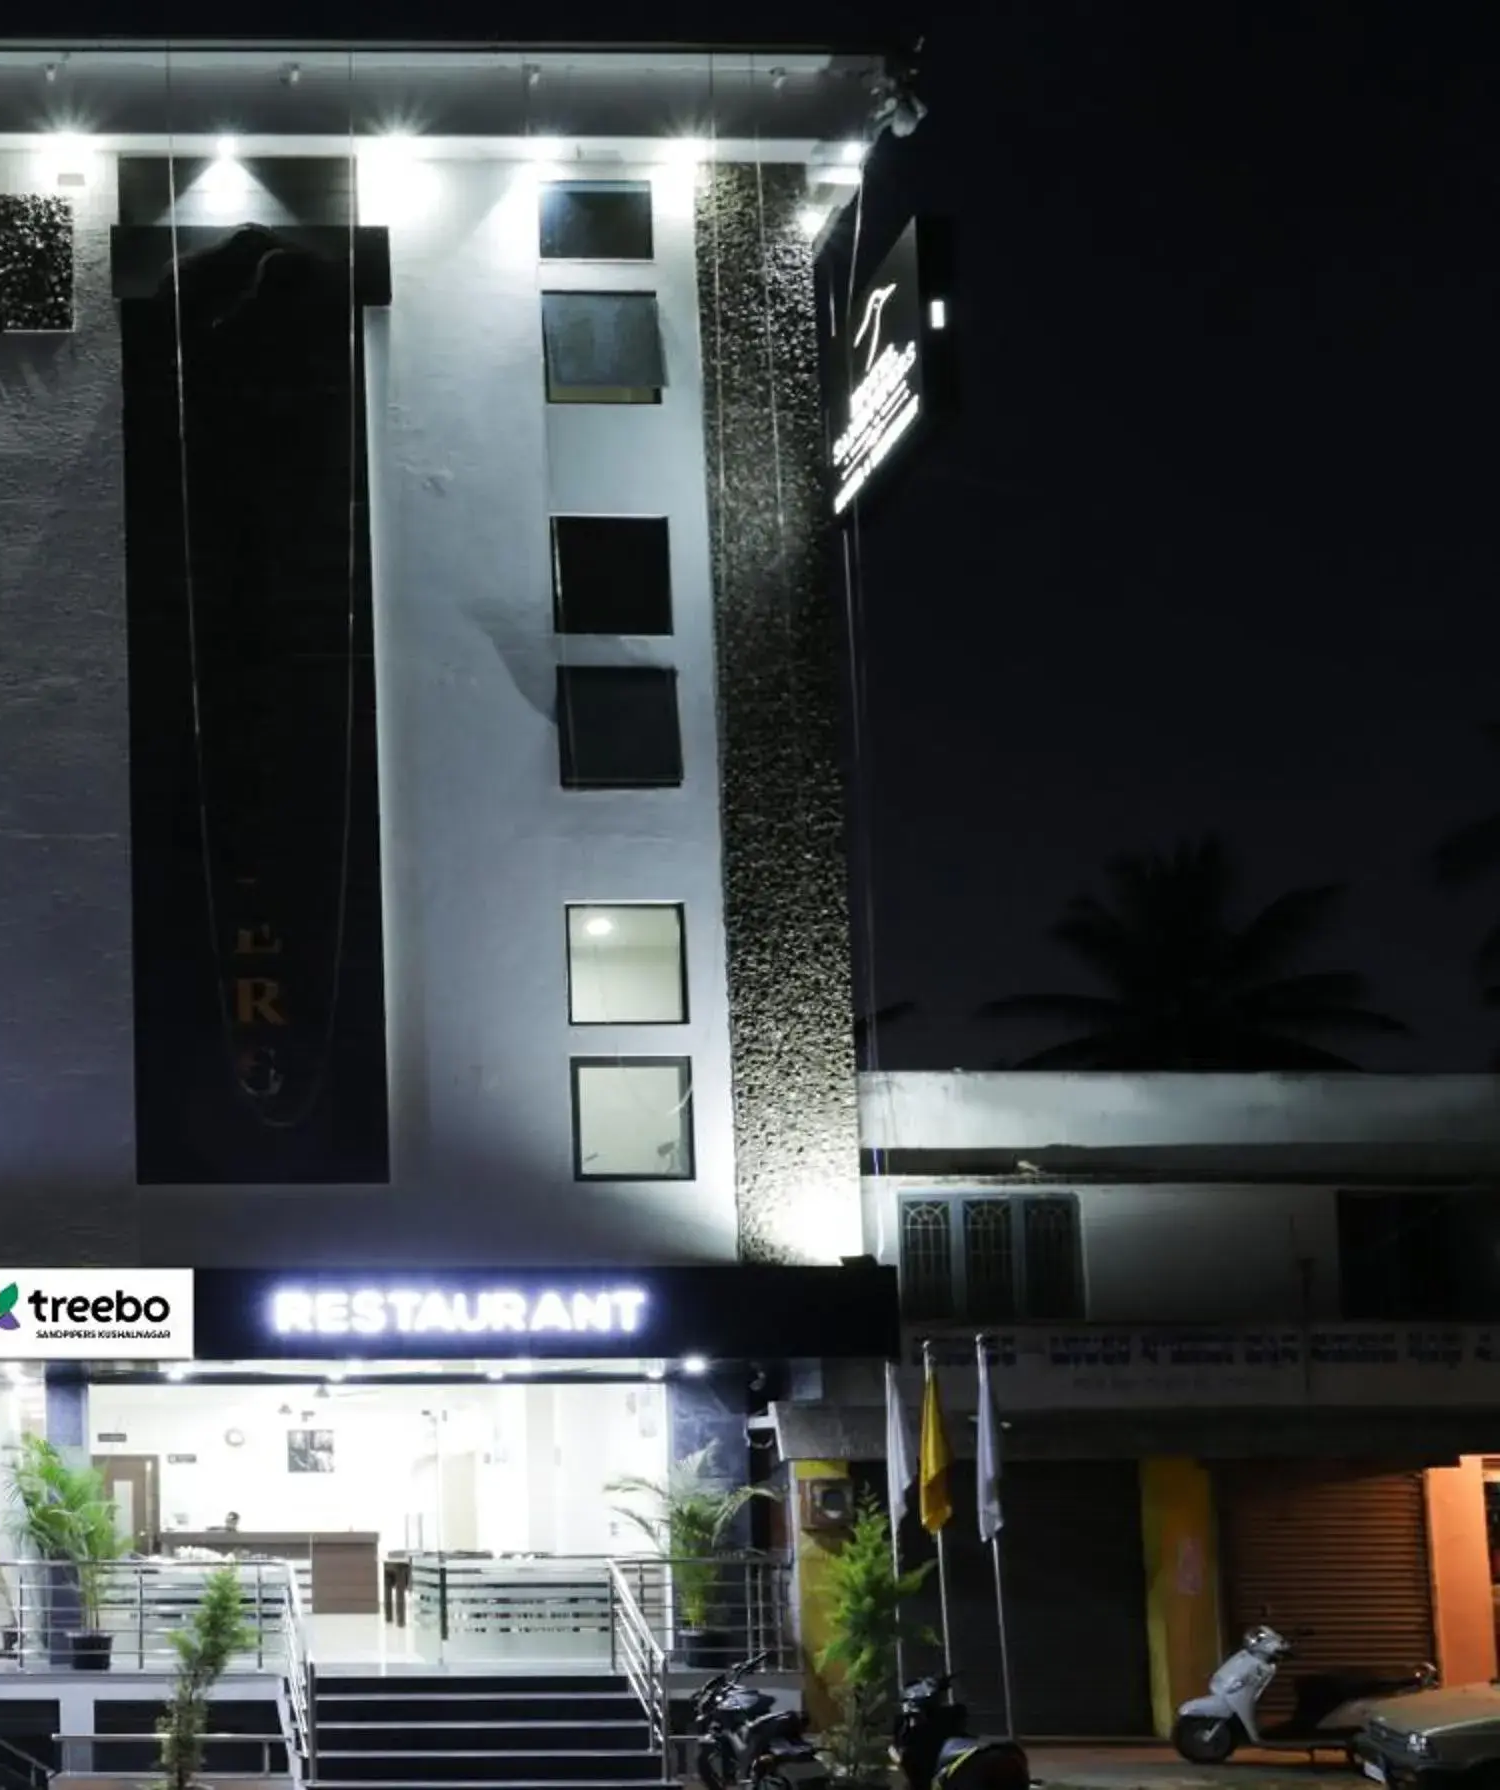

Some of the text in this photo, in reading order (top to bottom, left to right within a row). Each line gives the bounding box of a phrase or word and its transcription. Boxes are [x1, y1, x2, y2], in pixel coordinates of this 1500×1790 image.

[28, 1290, 171, 1323] treebo
[274, 1290, 644, 1333] RESTAURANT
[36, 1329, 171, 1339] SANDPIPERS KUSHALNAGAR
